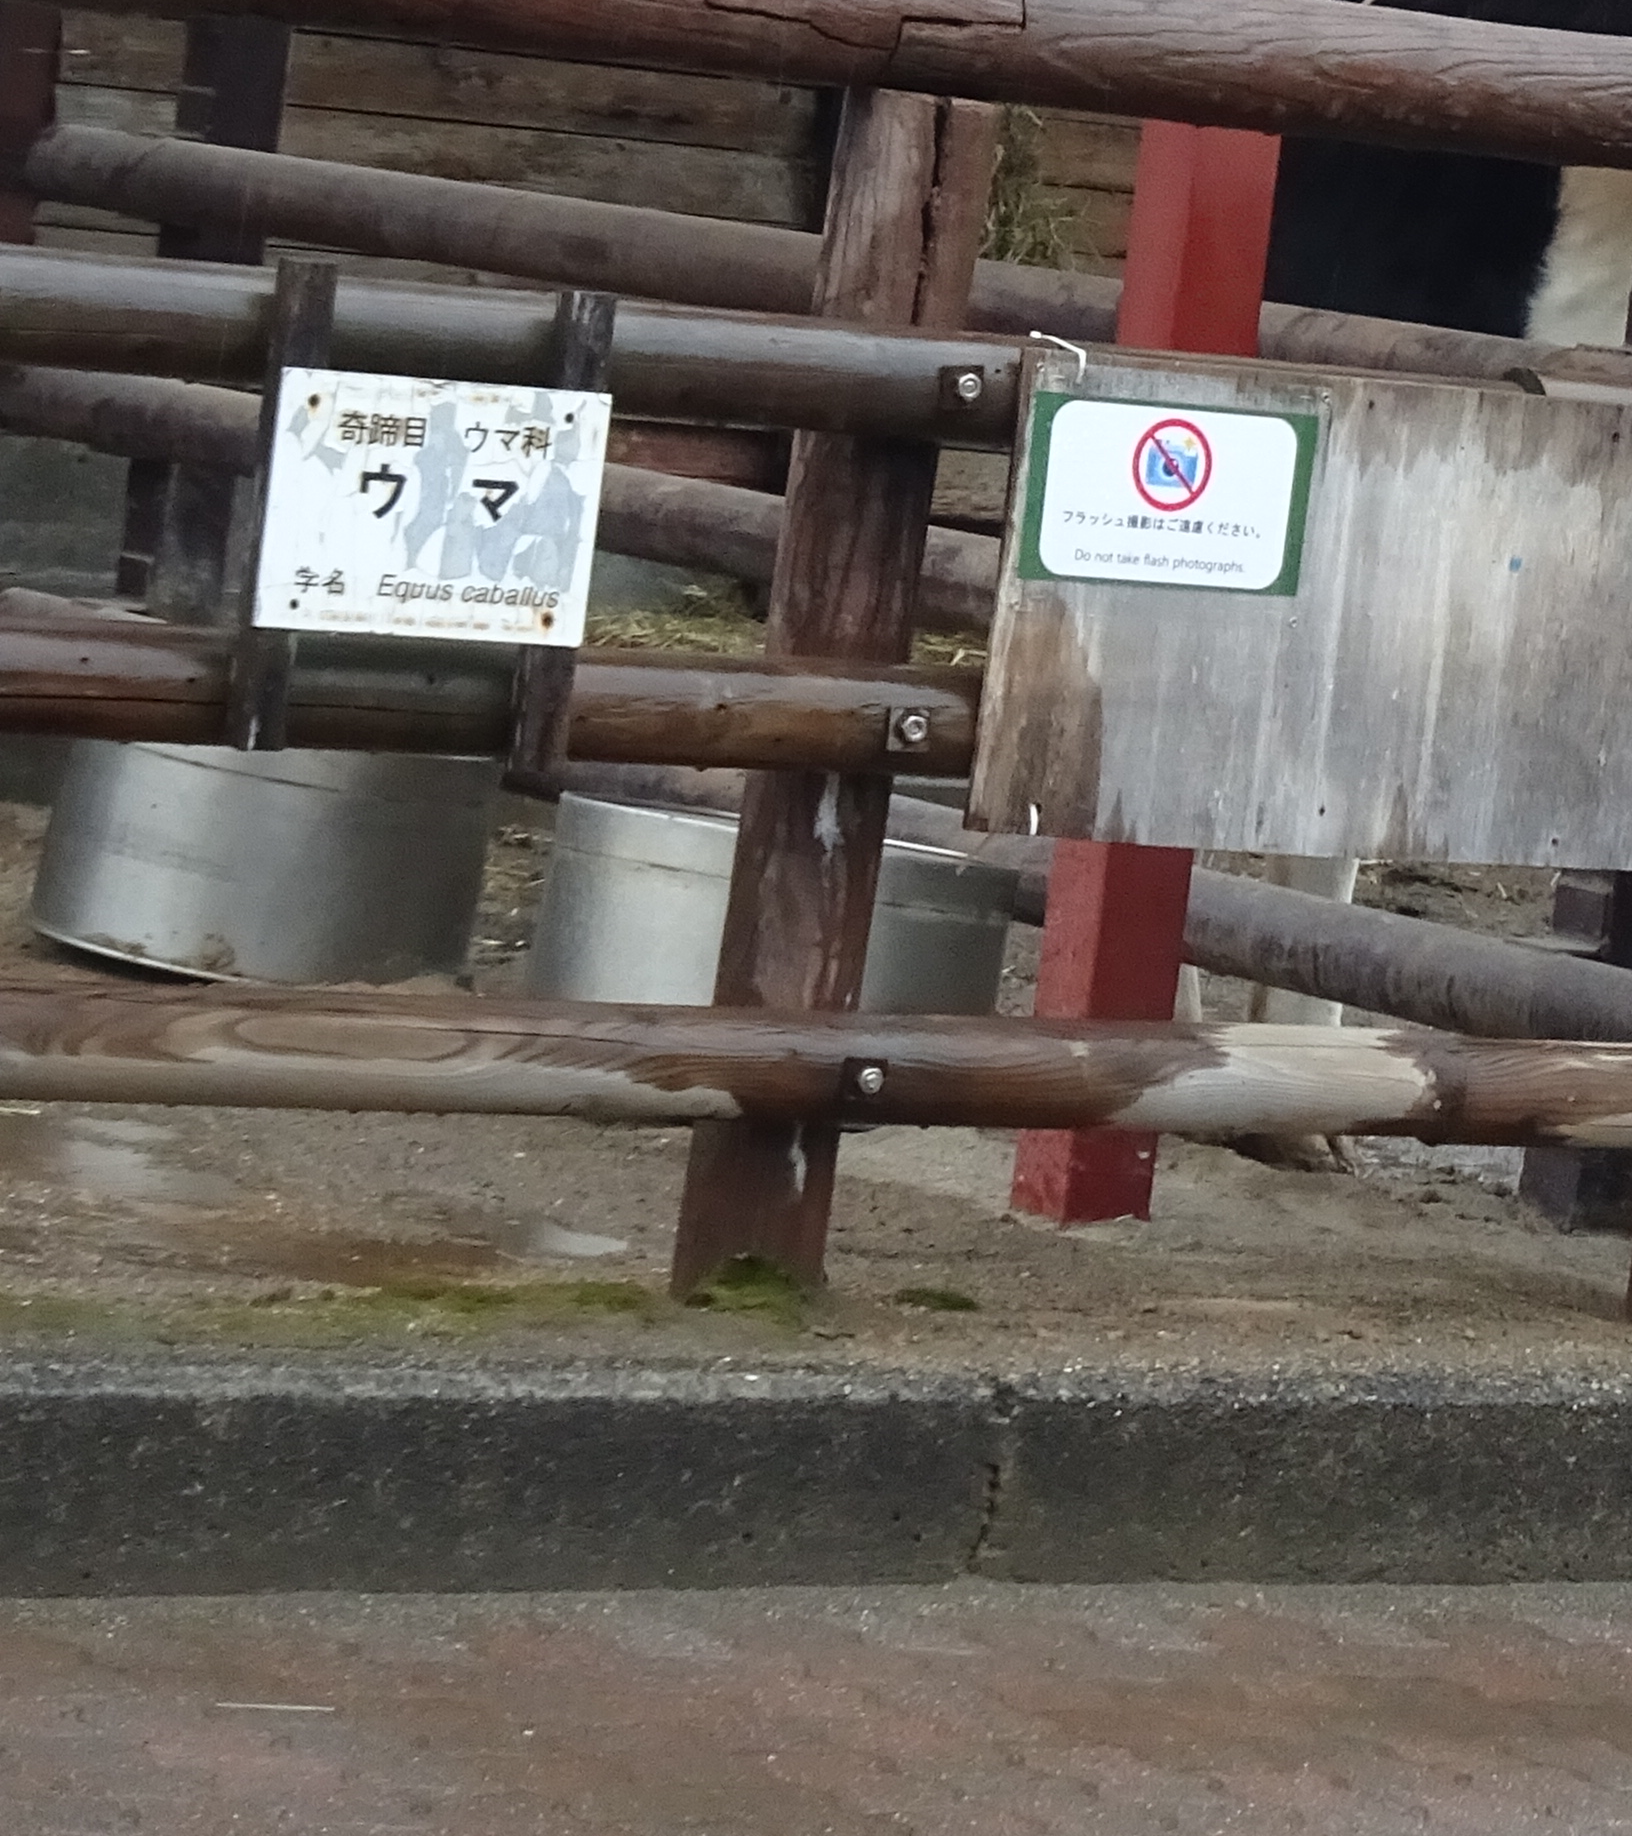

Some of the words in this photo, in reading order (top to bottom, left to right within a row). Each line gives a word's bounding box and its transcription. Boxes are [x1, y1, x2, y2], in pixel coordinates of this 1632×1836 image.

[337, 411, 428, 449] 奇蹄目
[464, 421, 552, 460] ウマ科
[1063, 510, 1261, 539] フラッシュ撮影はご遠慮ください。
[1074, 548, 1092, 562] Do
[1094, 550, 1114, 563] not
[1117, 553, 1140, 566] take
[1143, 553, 1170, 568] flash
[294, 566, 345, 595] 学名
[377, 574, 453, 604] Equus
[461, 583, 560, 608] caballus
